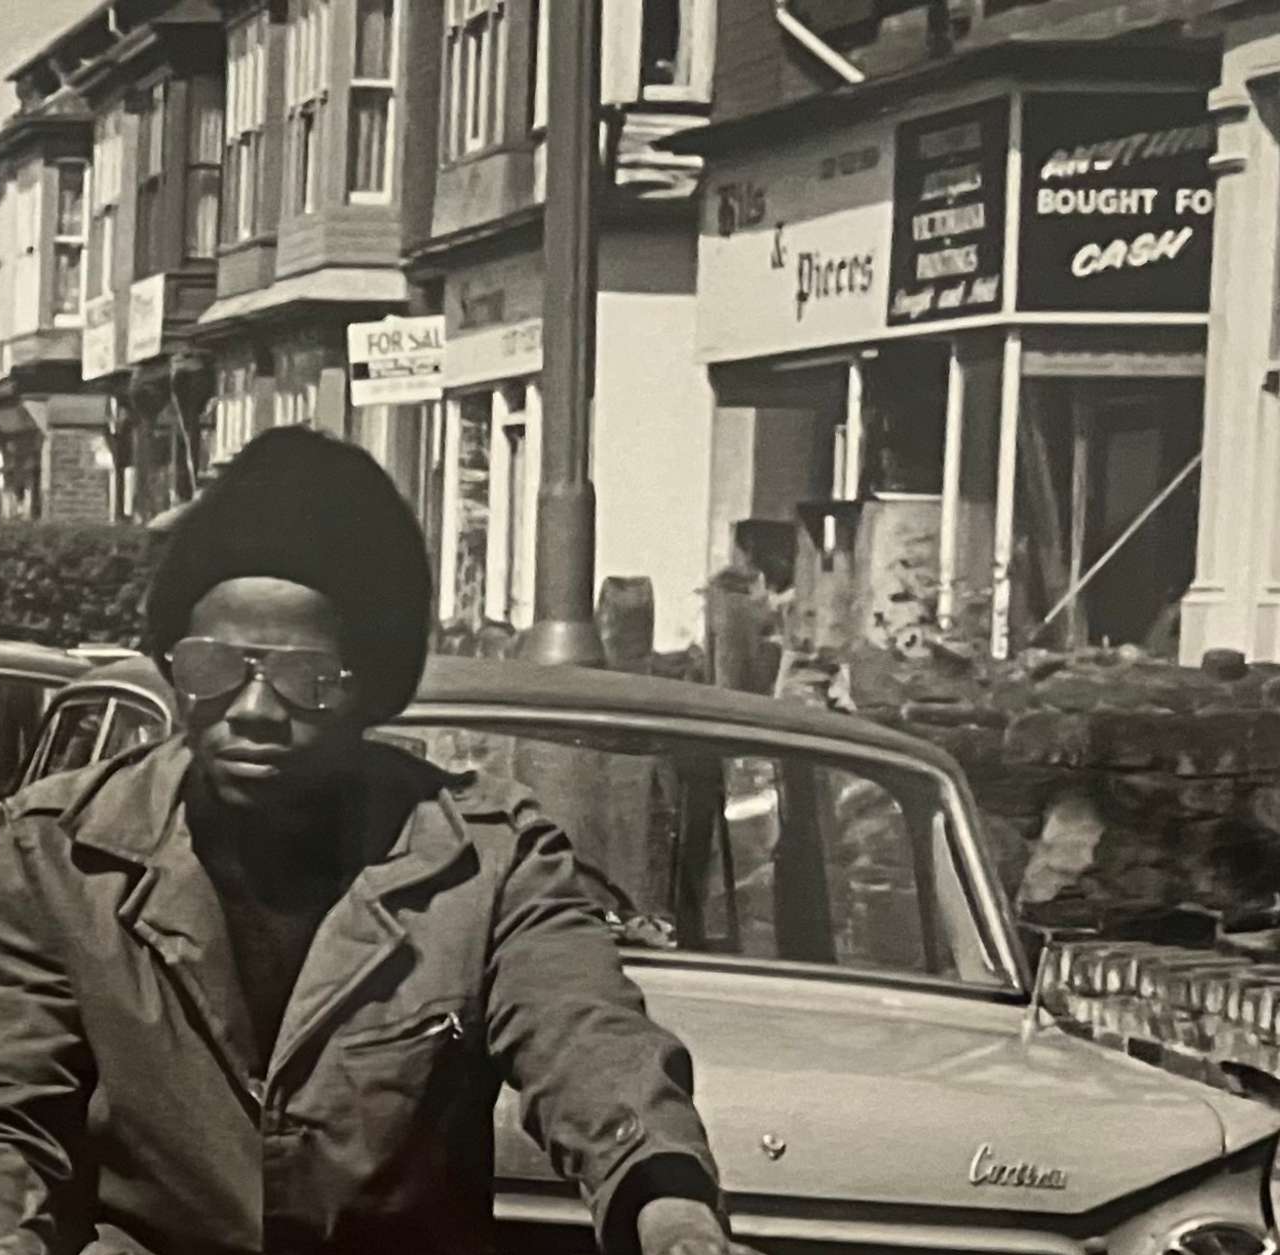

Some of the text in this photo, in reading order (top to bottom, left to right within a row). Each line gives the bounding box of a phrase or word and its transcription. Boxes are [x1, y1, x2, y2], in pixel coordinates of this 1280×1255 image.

[1037, 187, 1159, 216] BOUGHT
[1071, 226, 1194, 278] CASH
[366, 330, 404, 357] FOR
